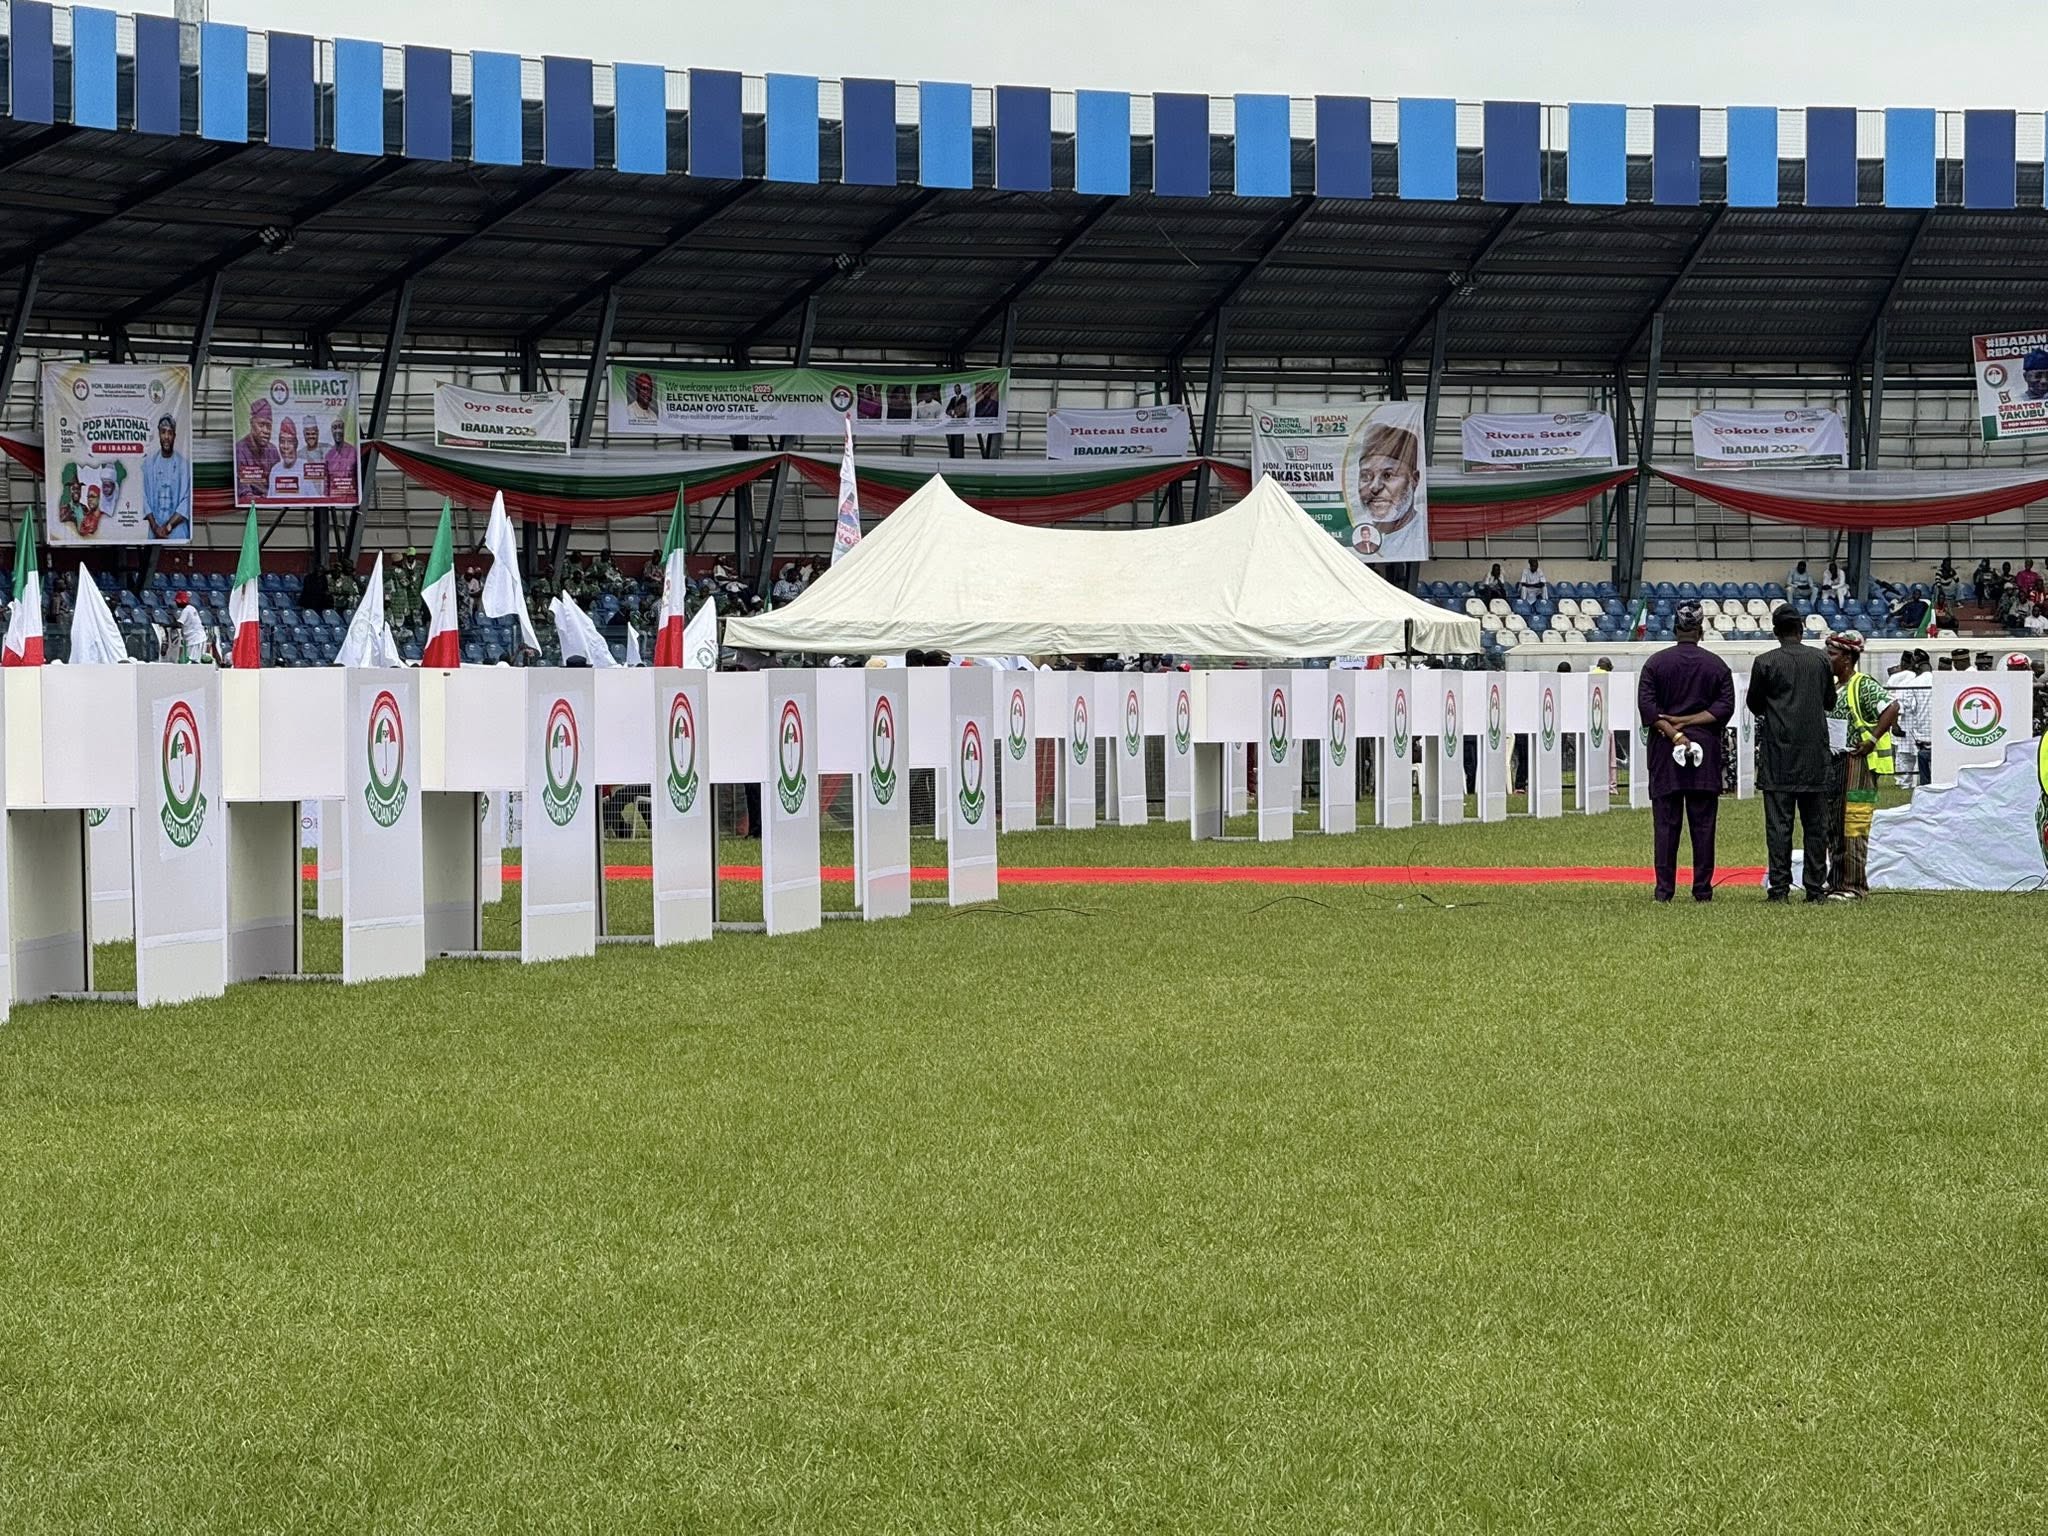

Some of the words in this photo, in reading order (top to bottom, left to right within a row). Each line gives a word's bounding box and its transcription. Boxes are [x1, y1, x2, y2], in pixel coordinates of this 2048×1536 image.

[1985, 334, 2047, 348] #IBADAN
[293, 379, 349, 396] IMPACT
[679, 382, 713, 392] welcome
[714, 384, 728, 393] you
[729, 383, 738, 391] to
[738, 383, 751, 391] the
[754, 385, 771, 393] 2025
[324, 398, 348, 407] 2027
[666, 393, 710, 402] ELECTIVE
[711, 393, 759, 403] NATIONAL
[761, 394, 824, 403] CONVENTION
[464, 402, 491, 412] Oyo
[495, 405, 534, 414] State
[666, 403, 703, 412] IBADAN
[705, 404, 726, 413] OYO
[1998, 402, 2042, 412] SENATOR
[1313, 415, 1348, 423] #IBADAN
[1999, 409, 2045, 420] YAKUBU
[82, 420, 102, 431] PDP
[104, 418, 151, 432] NATIONAL
[461, 422, 504, 435] IBADAN
[505, 426, 537, 437] 2025
[1713, 426, 1769, 435] Sokoto
[1774, 426, 1815, 434] State
[86, 430, 147, 442] CONVENTION
[1070, 427, 1125, 436] Plateau
[1130, 426, 1168, 435] State
[1485, 431, 1535, 440] Rivers
[1539, 430, 1582, 439] State
[1073, 446, 1118, 455] IBADAN
[1120, 445, 1153, 455] 2025
[1491, 448, 1539, 458] IBADAN
[1721, 445, 1769, 454] IBADAN
[1262, 462, 1281, 470] HON.
[1285, 462, 1333, 471] THEOPHILUS
[1303, 471, 1334, 482] SHAN
[1951, 728, 1983, 746] IBADAN
[1984, 729, 2003, 745] 2025
[367, 788, 392, 825] IBADAN
[544, 791, 567, 824] IBADAN
[163, 810, 190, 845] IBADAN
